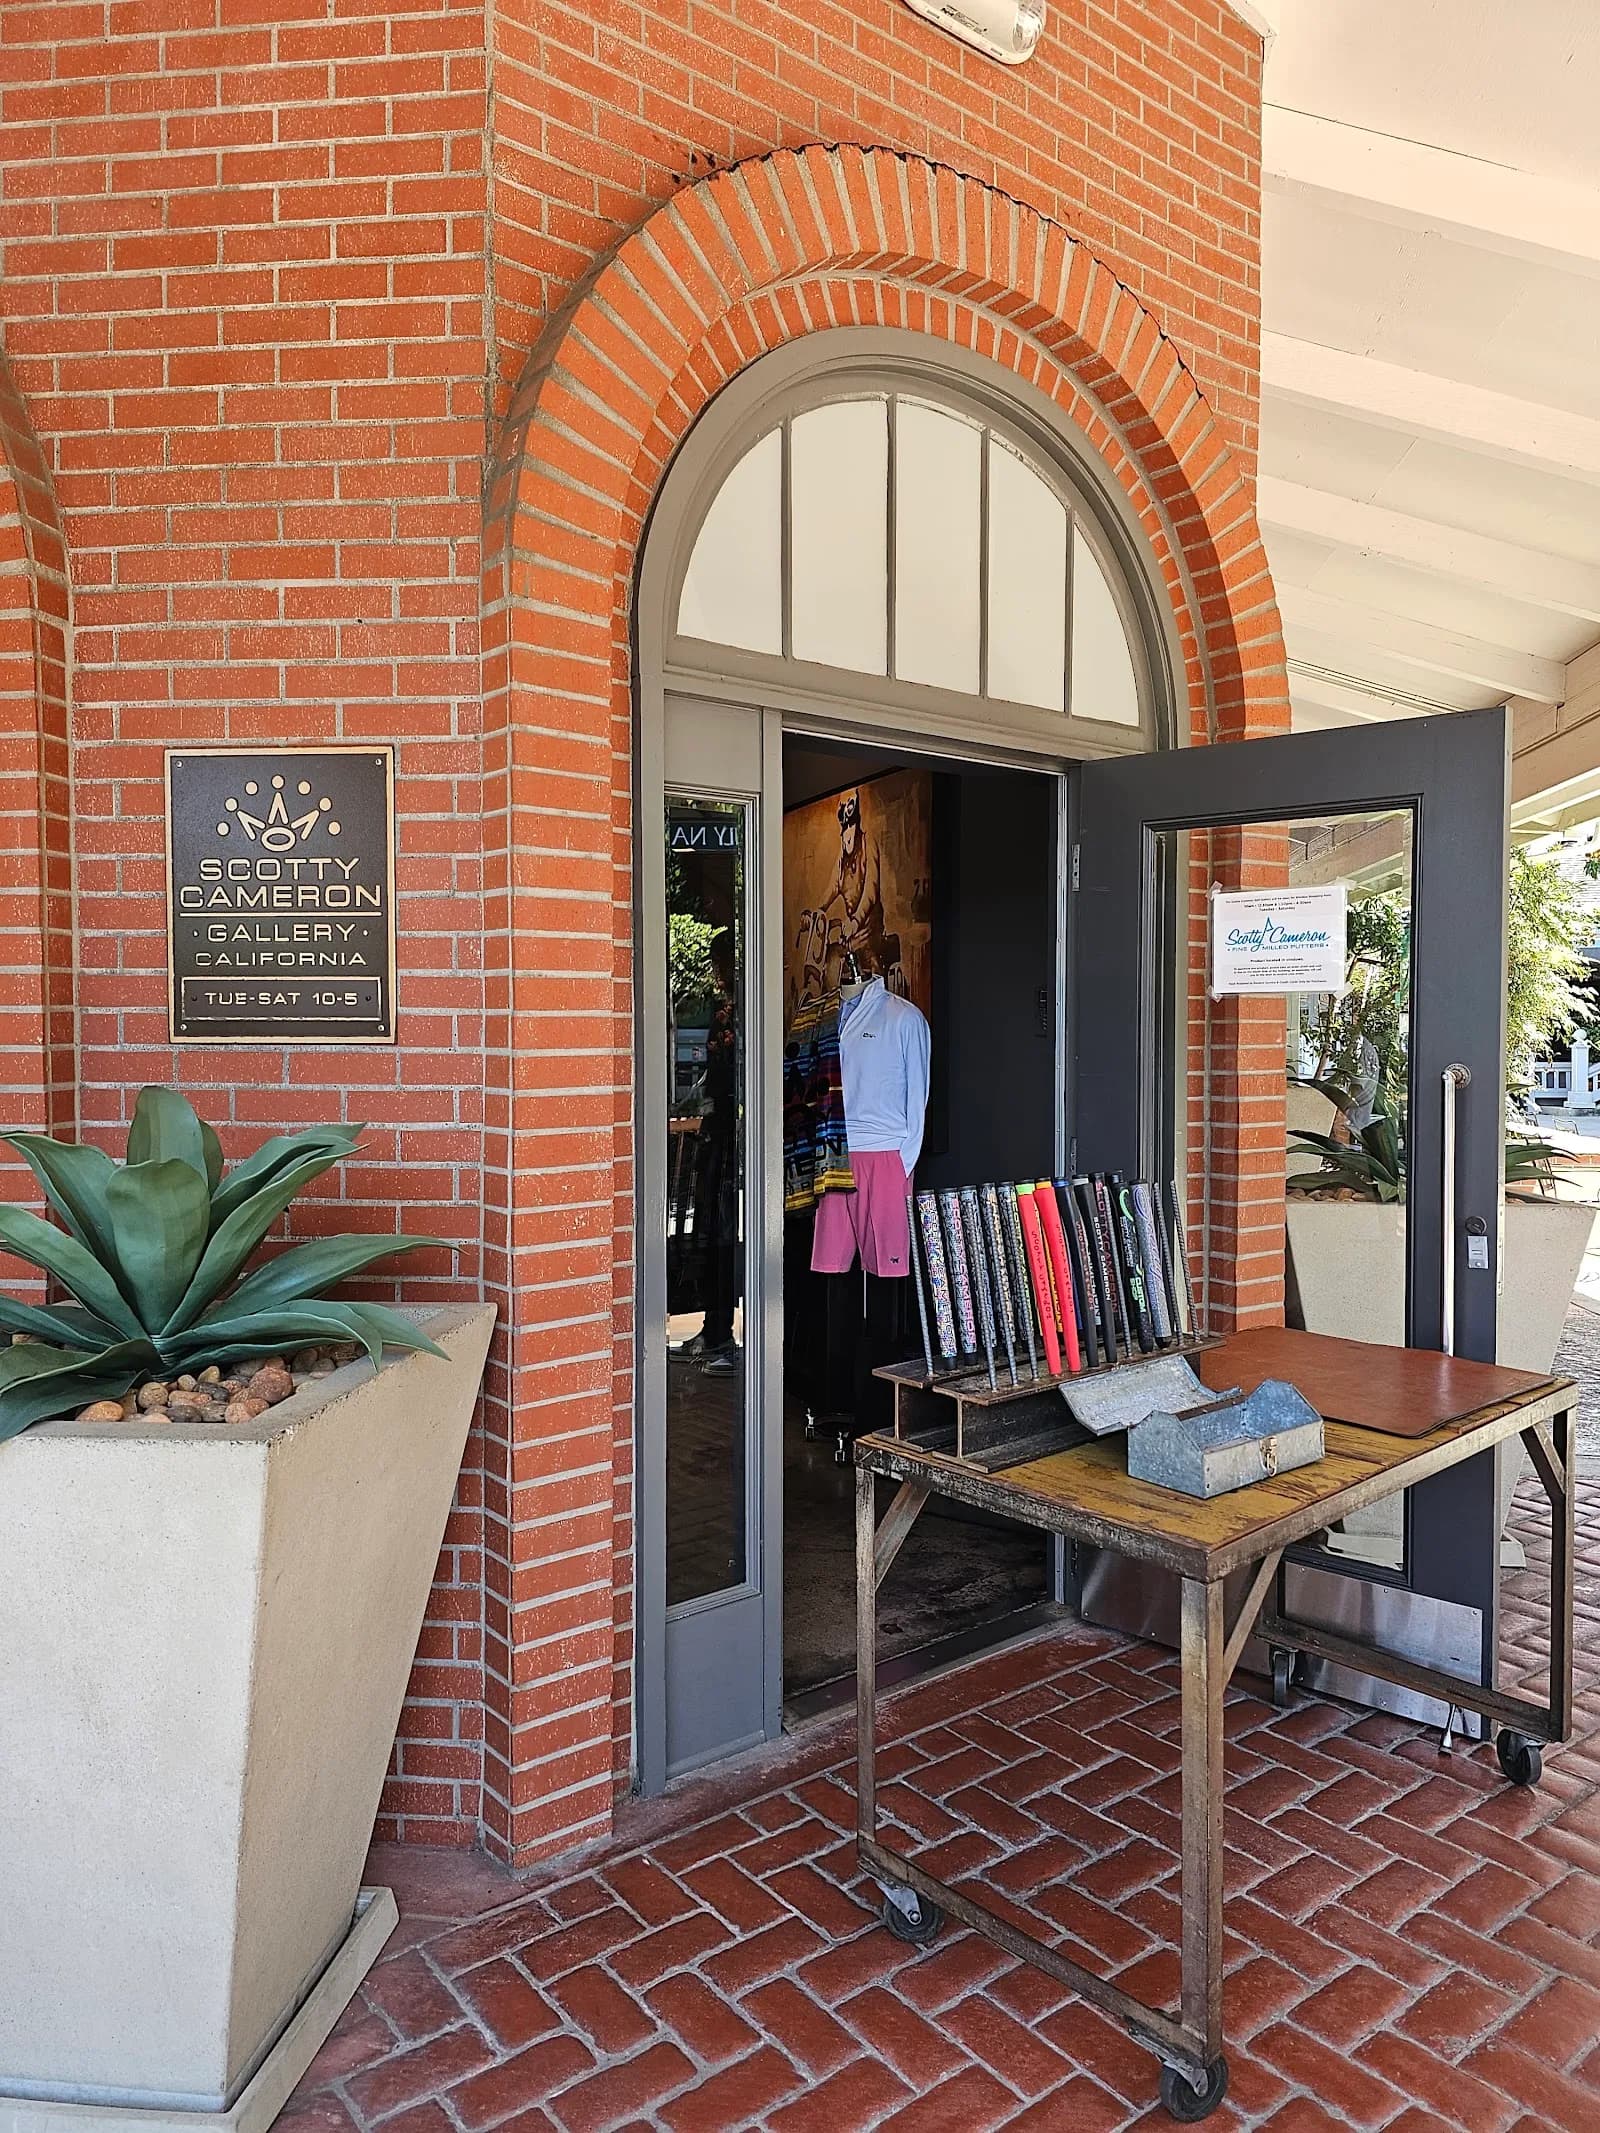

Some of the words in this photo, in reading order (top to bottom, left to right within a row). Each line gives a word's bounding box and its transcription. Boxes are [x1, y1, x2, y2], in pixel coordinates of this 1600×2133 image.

[200, 857, 360, 881] SCOTTY
[180, 885, 381, 908] CAMERON
[208, 924, 356, 942] GALLERY
[1225, 925, 1265, 952] Scotty
[1269, 926, 1331, 943] Cameron
[195, 952, 367, 966] CALIFORNIA
[205, 992, 301, 1005] TUE-SAT
[312, 992, 358, 1005] 10-5
[1094, 1216, 1104, 1252] SCOTTY
[1100, 1255, 1111, 1300] CAMERON
[1135, 1277, 1146, 1313] CUSTOM
